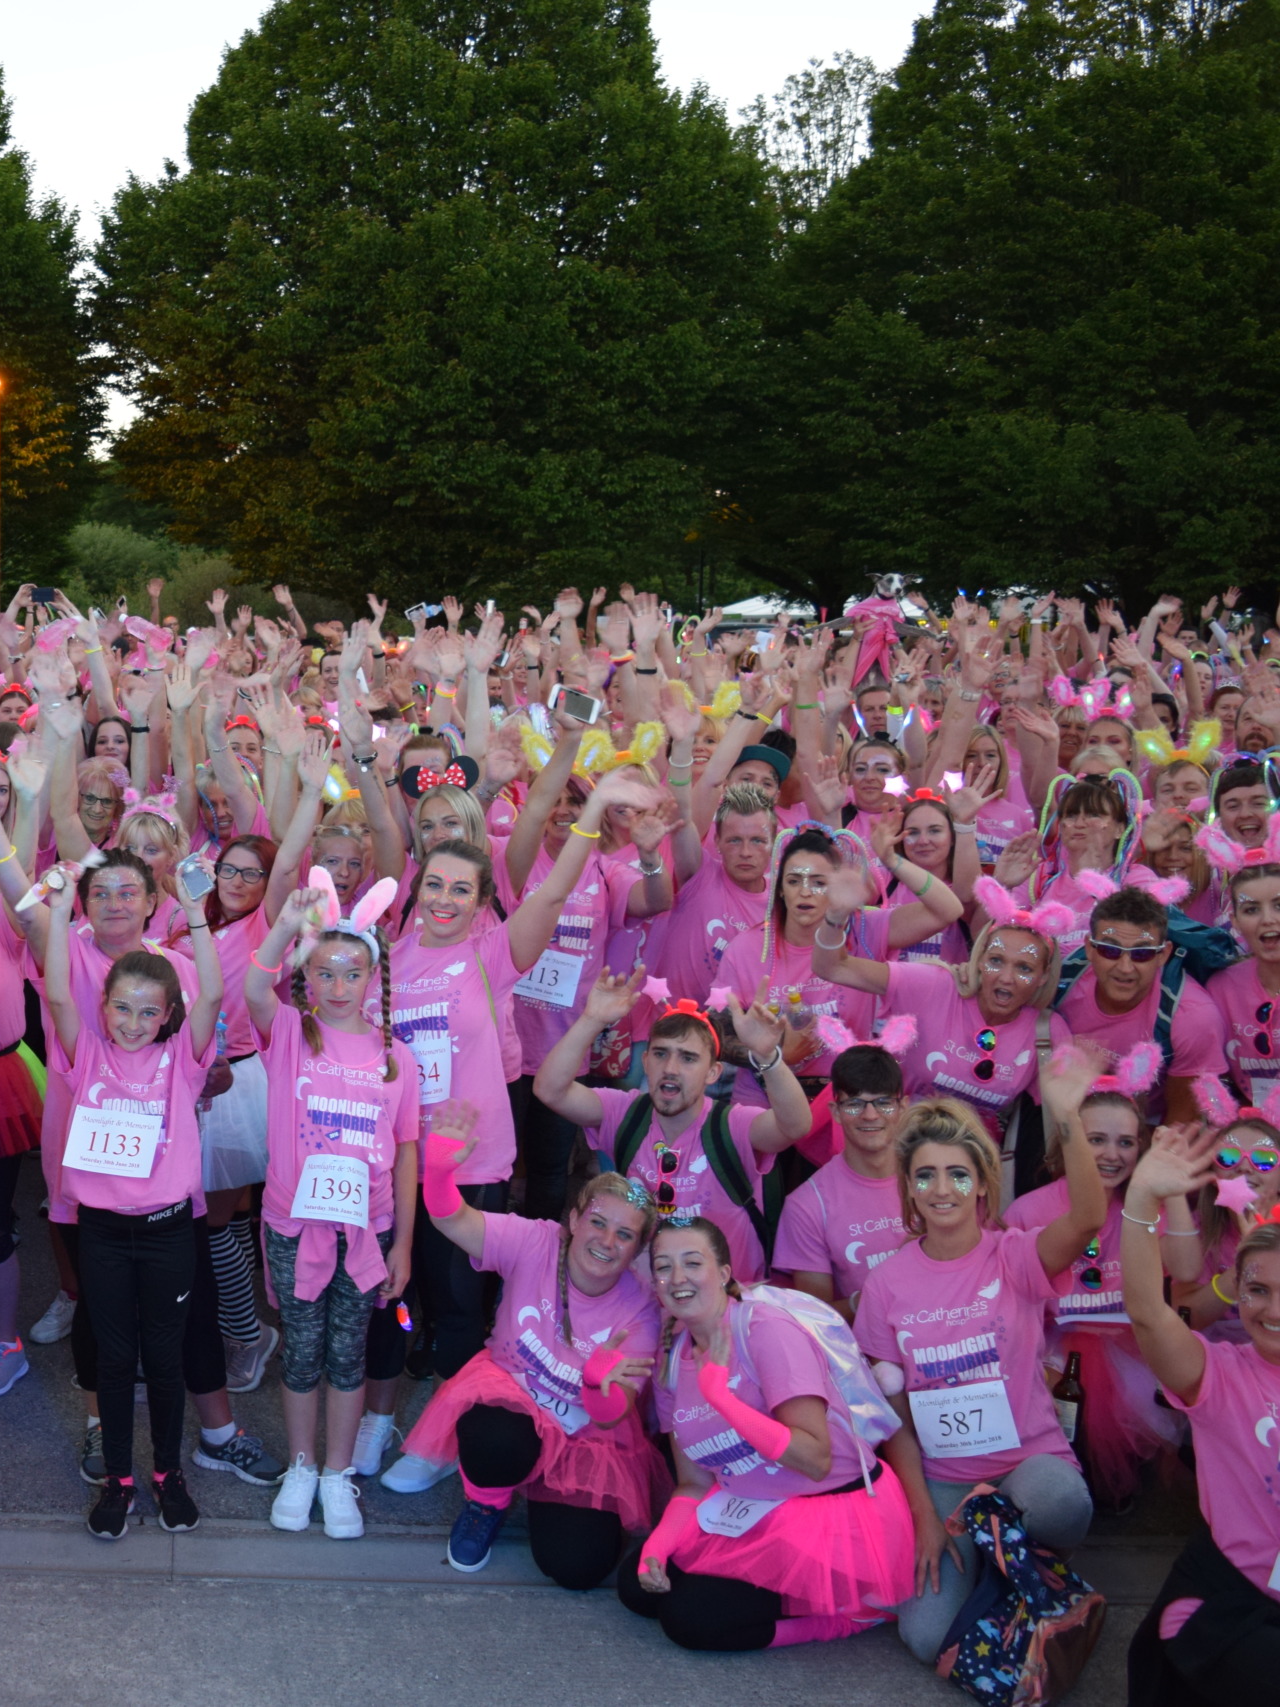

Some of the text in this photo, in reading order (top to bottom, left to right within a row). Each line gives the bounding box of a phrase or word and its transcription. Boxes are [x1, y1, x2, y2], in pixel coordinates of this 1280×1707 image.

[559, 936, 589, 951] WALK
[302, 1058, 384, 1084] St Catherine's
[342, 1076, 368, 1088] hospice
[934, 1072, 1008, 1105] MOONLIGHT
[307, 1094, 382, 1121] MOONLIGHT
[82, 1116, 115, 1128] Moonlight
[124, 1120, 156, 1130] Memories
[88, 1131, 142, 1158] 1133
[342, 1128, 374, 1149] WALK
[80, 1156, 104, 1165] Saturday
[310, 1176, 363, 1205] 1395
[148, 1206, 172, 1223] NIKE
[304, 1204, 326, 1213] Saturday
[340, 1208, 352, 1216] June
[848, 1222, 862, 1237] St
[1059, 1290, 1122, 1308] MOONLIG
[901, 1313, 915, 1326] St
[912, 1332, 996, 1365] MOONLIGHT
[959, 1361, 1001, 1382] WALK
[917, 1391, 999, 1409] Moonlight & Memories
[938, 1408, 983, 1436] 587
[934, 1440, 958, 1450] Saturday
[973, 1437, 987, 1446] June
[726, 1452, 766, 1476] WALK
[720, 1497, 756, 1520] 816
